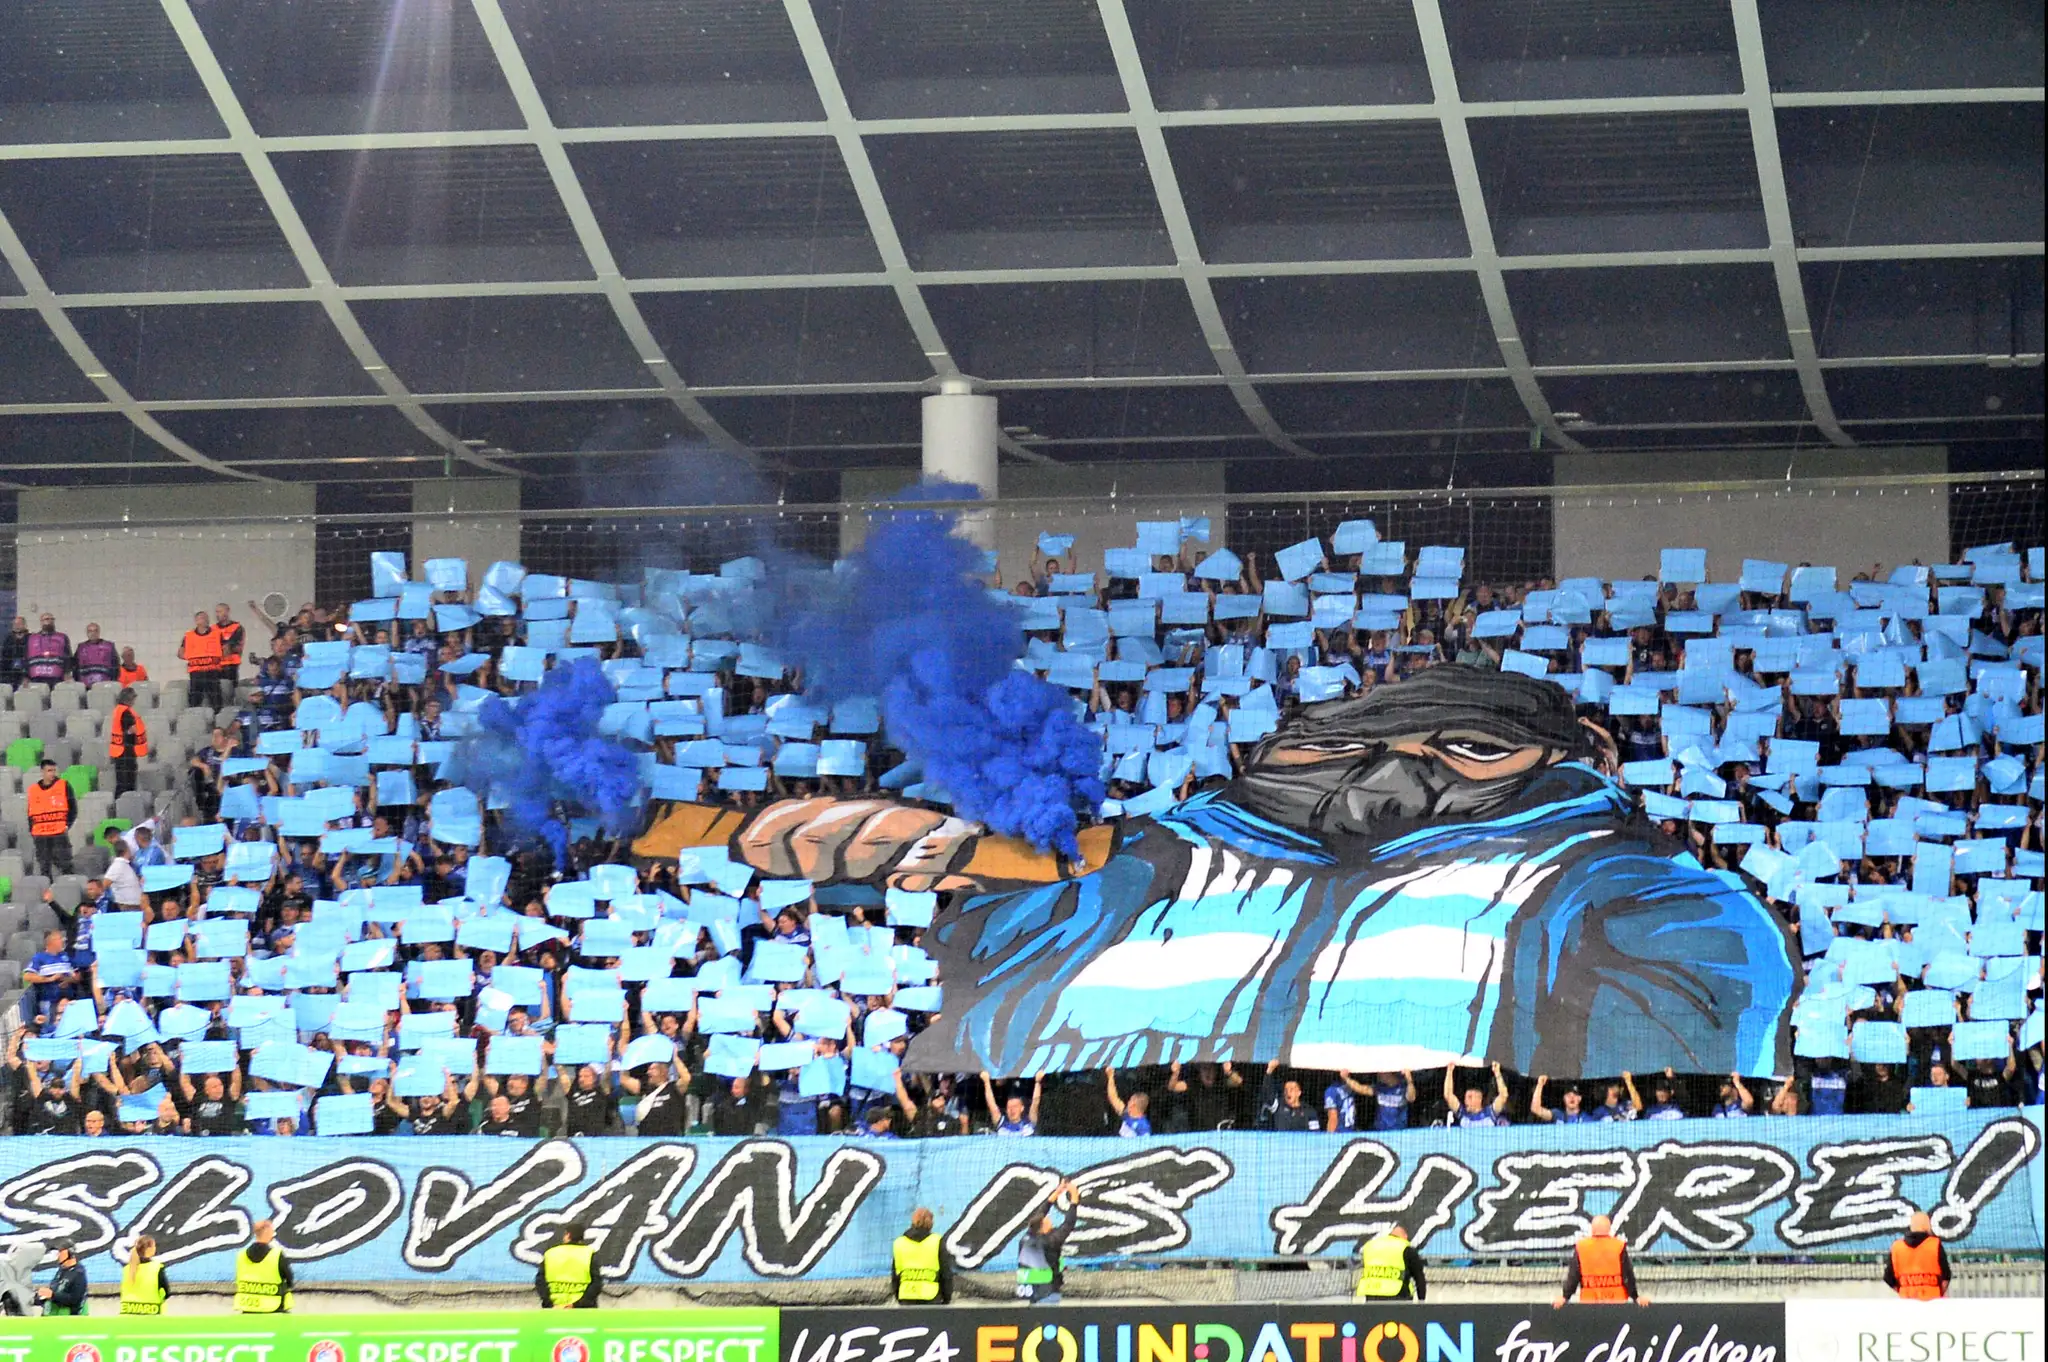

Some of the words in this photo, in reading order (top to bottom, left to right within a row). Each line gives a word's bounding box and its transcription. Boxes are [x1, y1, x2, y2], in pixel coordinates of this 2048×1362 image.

[0, 1139, 885, 1279] SLOVAN
[945, 1144, 1235, 1269] IS
[1270, 1115, 2042, 1257] HERE!
[359, 1341, 518, 1362] RESPECT
[603, 1338, 766, 1362] RESPECT
[788, 1326, 960, 1362] UEFA
[1496, 1319, 1570, 1362] for
[1583, 1322, 1777, 1362] children
[1858, 1330, 2035, 1362] RESPECT
